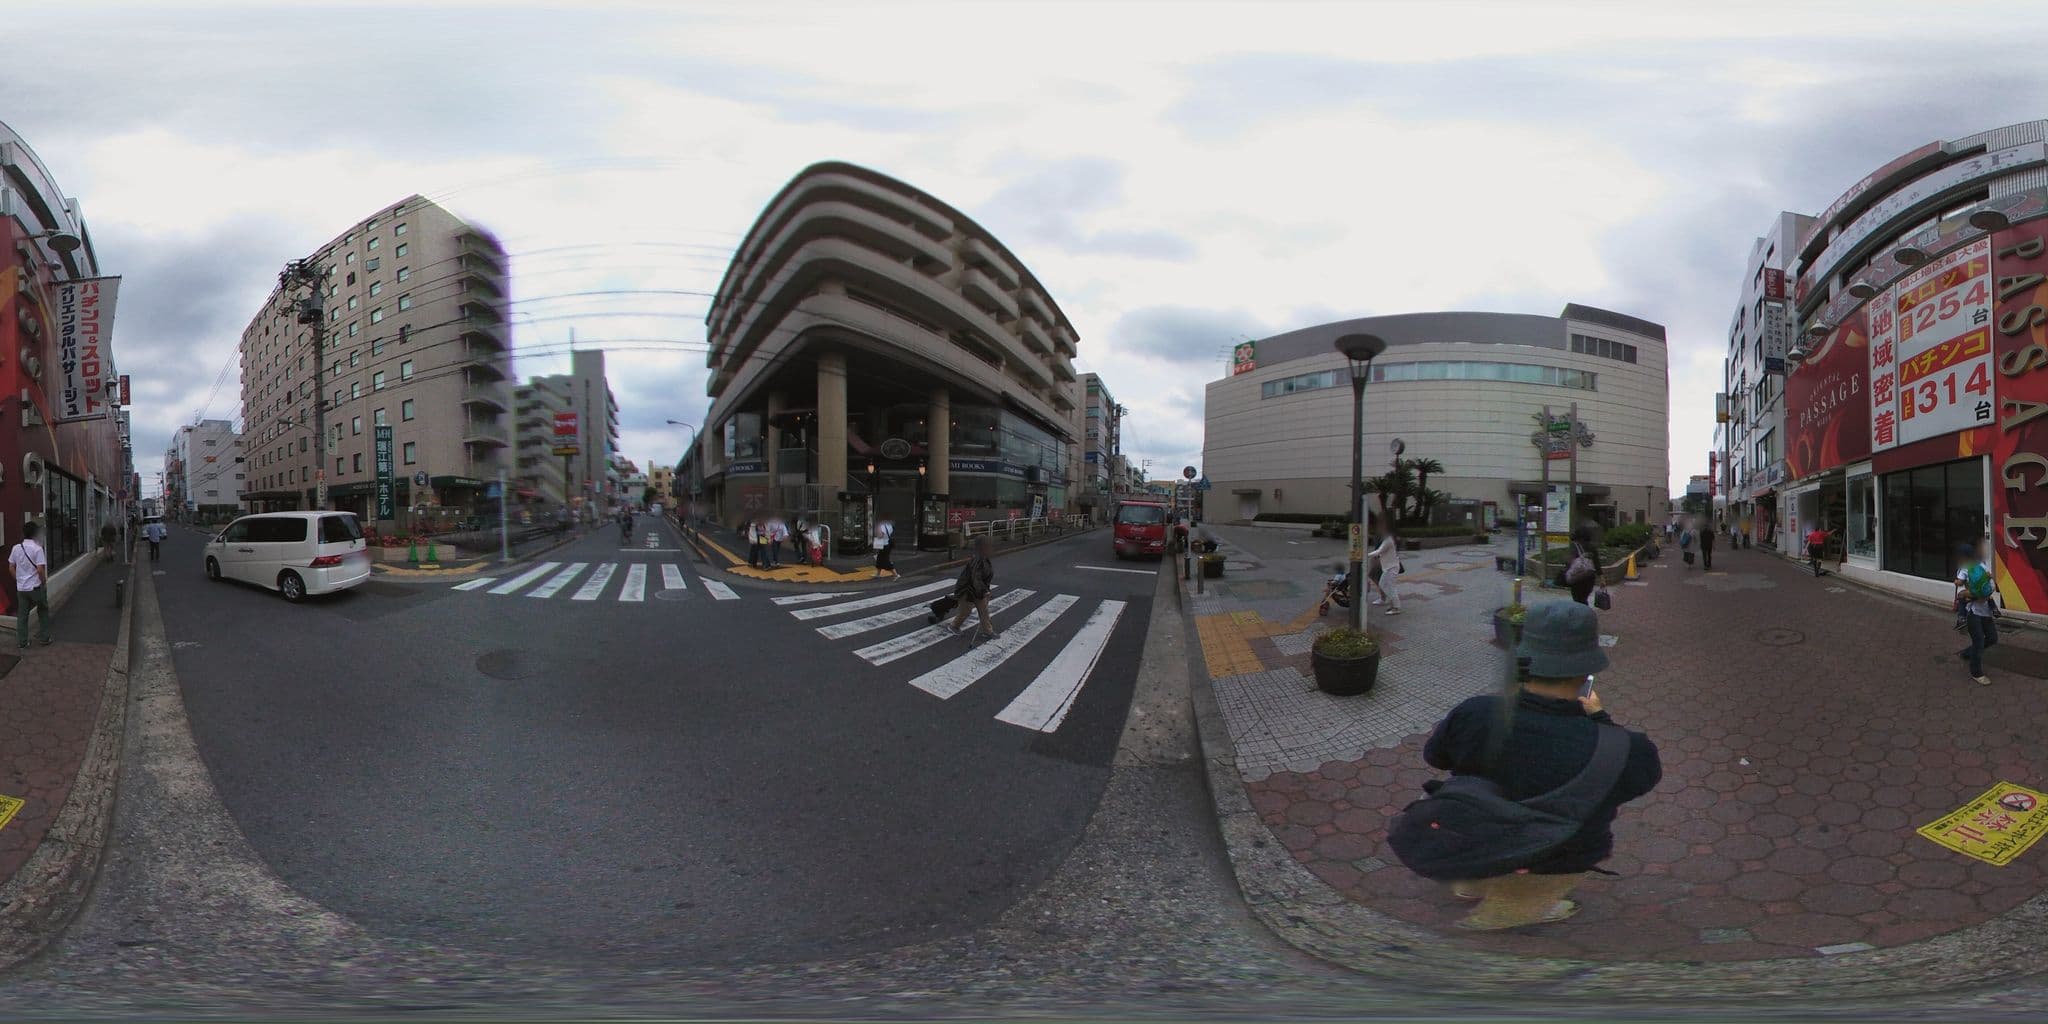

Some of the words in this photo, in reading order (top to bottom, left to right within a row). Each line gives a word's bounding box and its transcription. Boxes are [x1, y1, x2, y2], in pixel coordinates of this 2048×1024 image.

[1900, 260, 1984, 311] スロット
[1916, 279, 1990, 333] 254
[1972, 308, 1988, 326] 台
[1871, 309, 1895, 446] 地域密着
[1901, 331, 1985, 381] パチンコ
[1800, 373, 1859, 428] PASSAGE
[1903, 392, 1912, 418] 1F
[1918, 362, 1991, 414] 314
[1974, 400, 1991, 421] 台
[962, 462, 985, 470] BOOKS
[1941, 808, 2017, 844] 禁止
